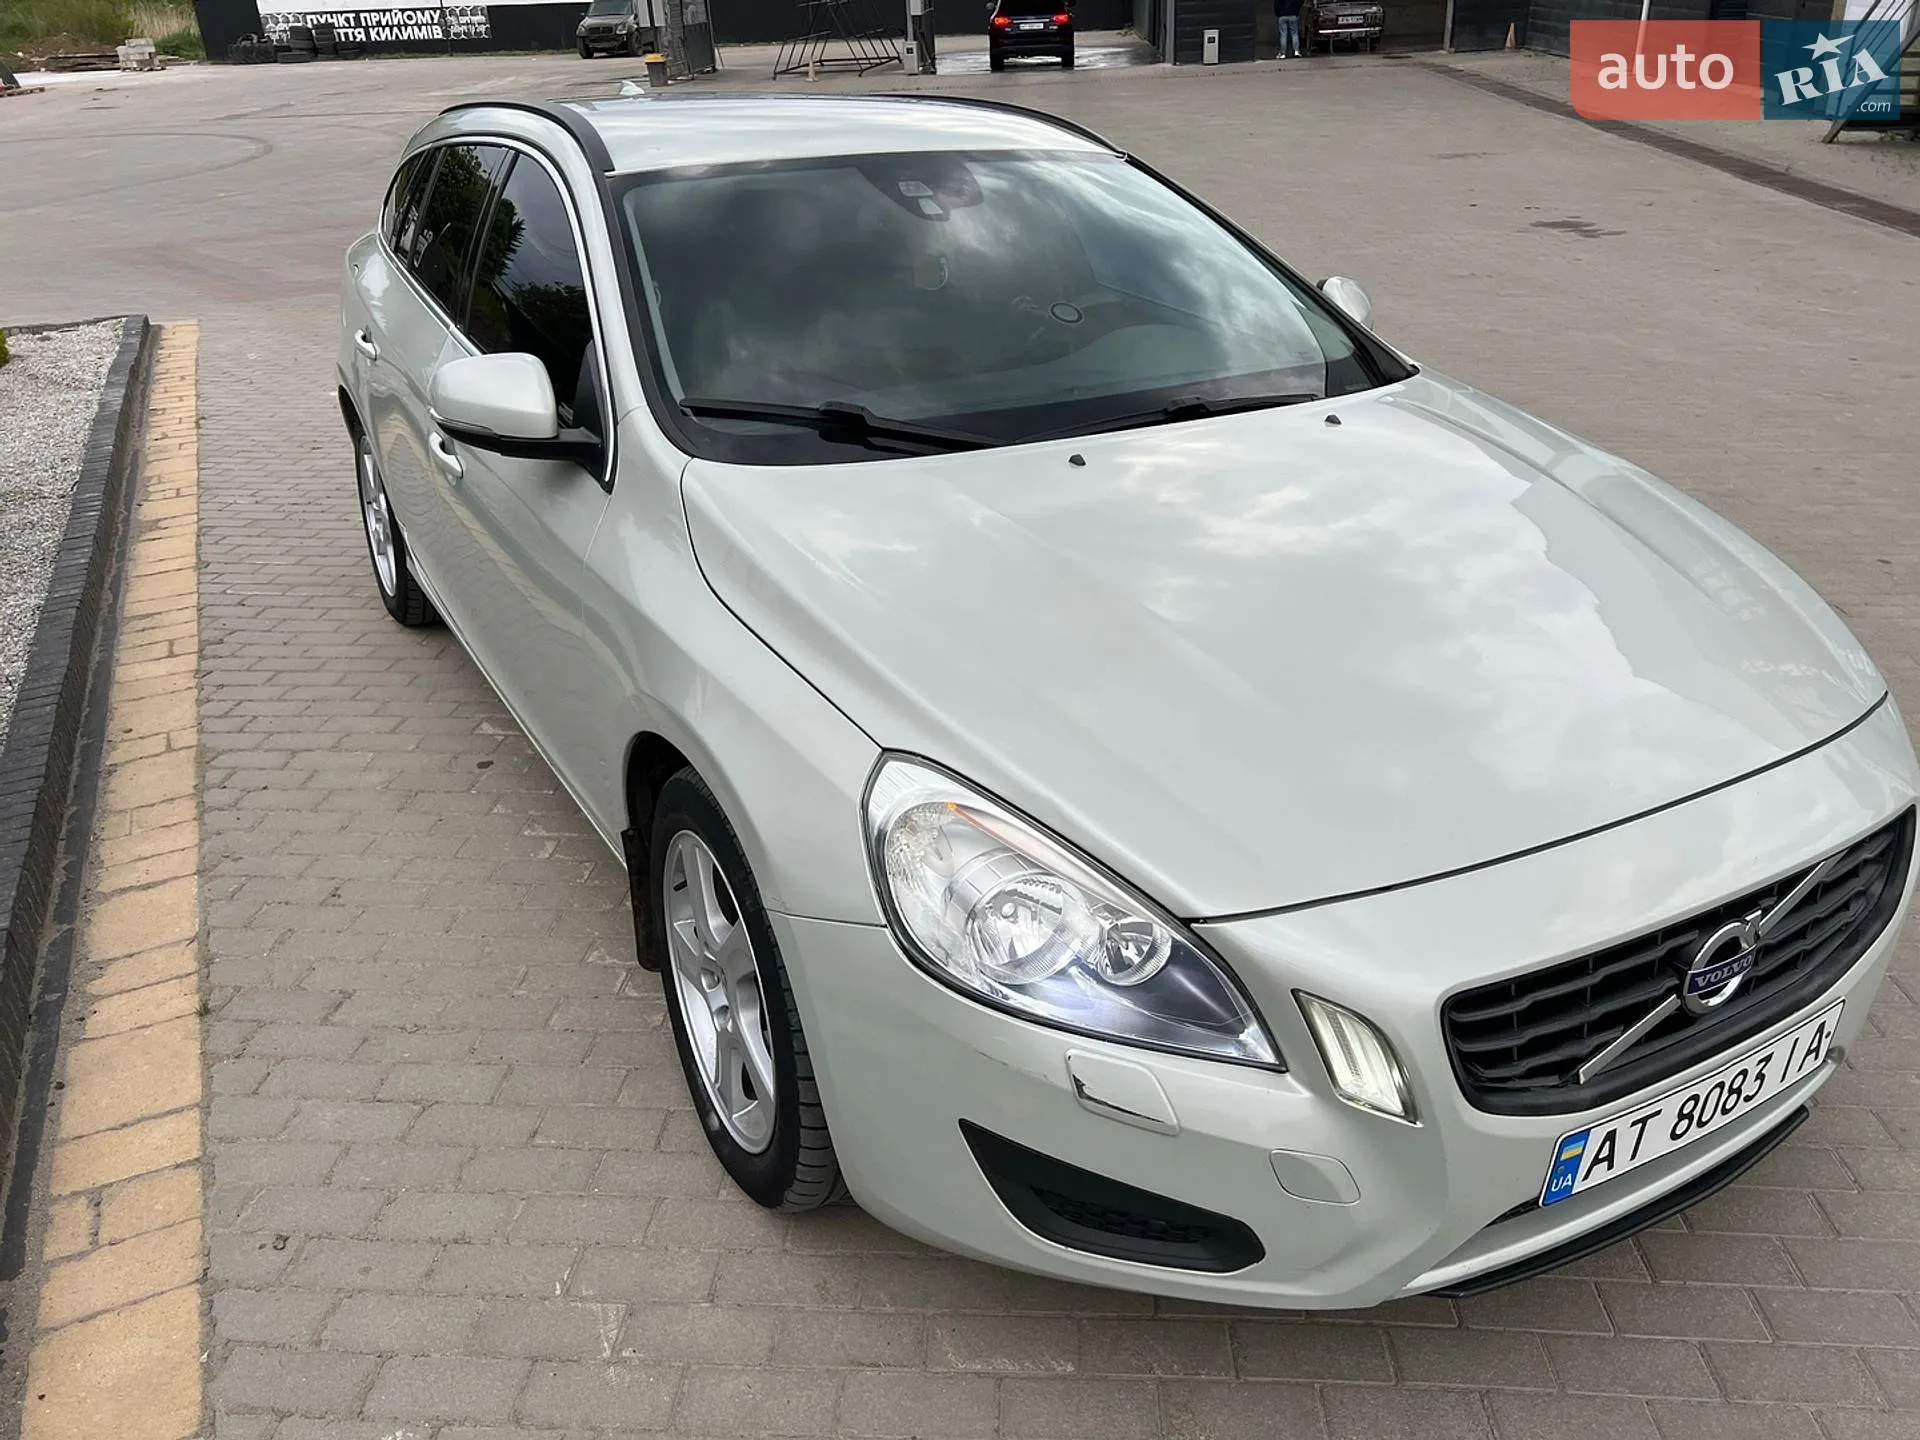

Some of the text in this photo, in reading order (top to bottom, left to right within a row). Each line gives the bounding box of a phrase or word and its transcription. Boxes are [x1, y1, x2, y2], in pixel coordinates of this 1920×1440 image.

[306, 13, 356, 28] ПУНКТ
[359, 9, 440, 27] ПРИЙОМУ
[369, 25, 443, 41] КИЛИМІВ
[1694, 954, 1752, 987] VOLVO
[1582, 1020, 1827, 1182] AT 8083 IA
[1551, 1173, 1573, 1192] UA
